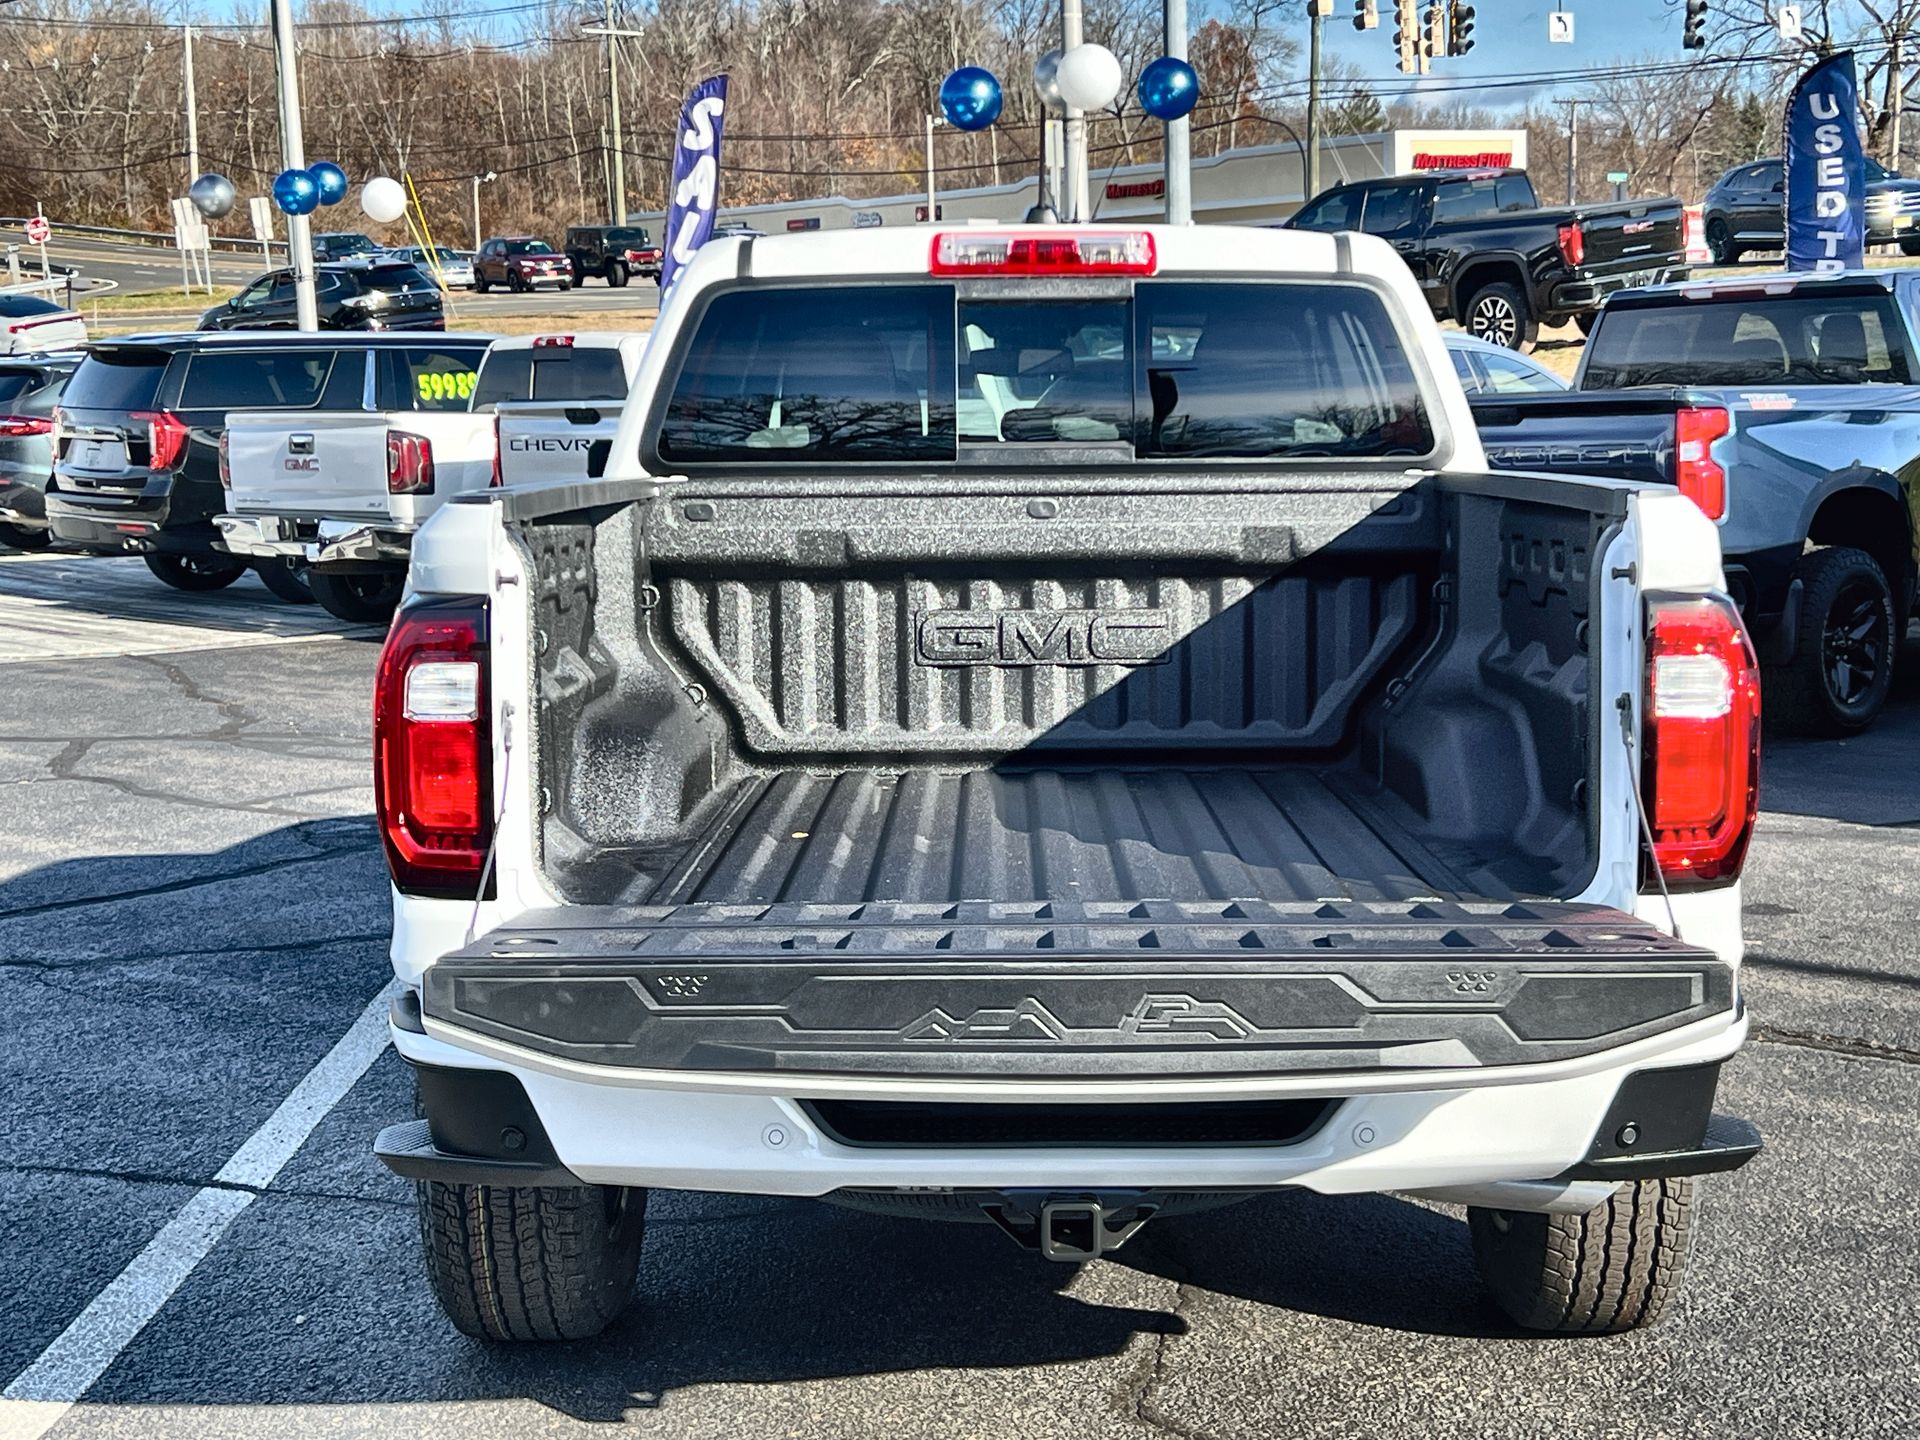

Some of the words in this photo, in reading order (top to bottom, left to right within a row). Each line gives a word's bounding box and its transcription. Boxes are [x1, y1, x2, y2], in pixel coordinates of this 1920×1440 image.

[1808, 93, 1847, 218] USED
[284, 458, 320, 472] GMC
[917, 610, 1170, 662] GMC
